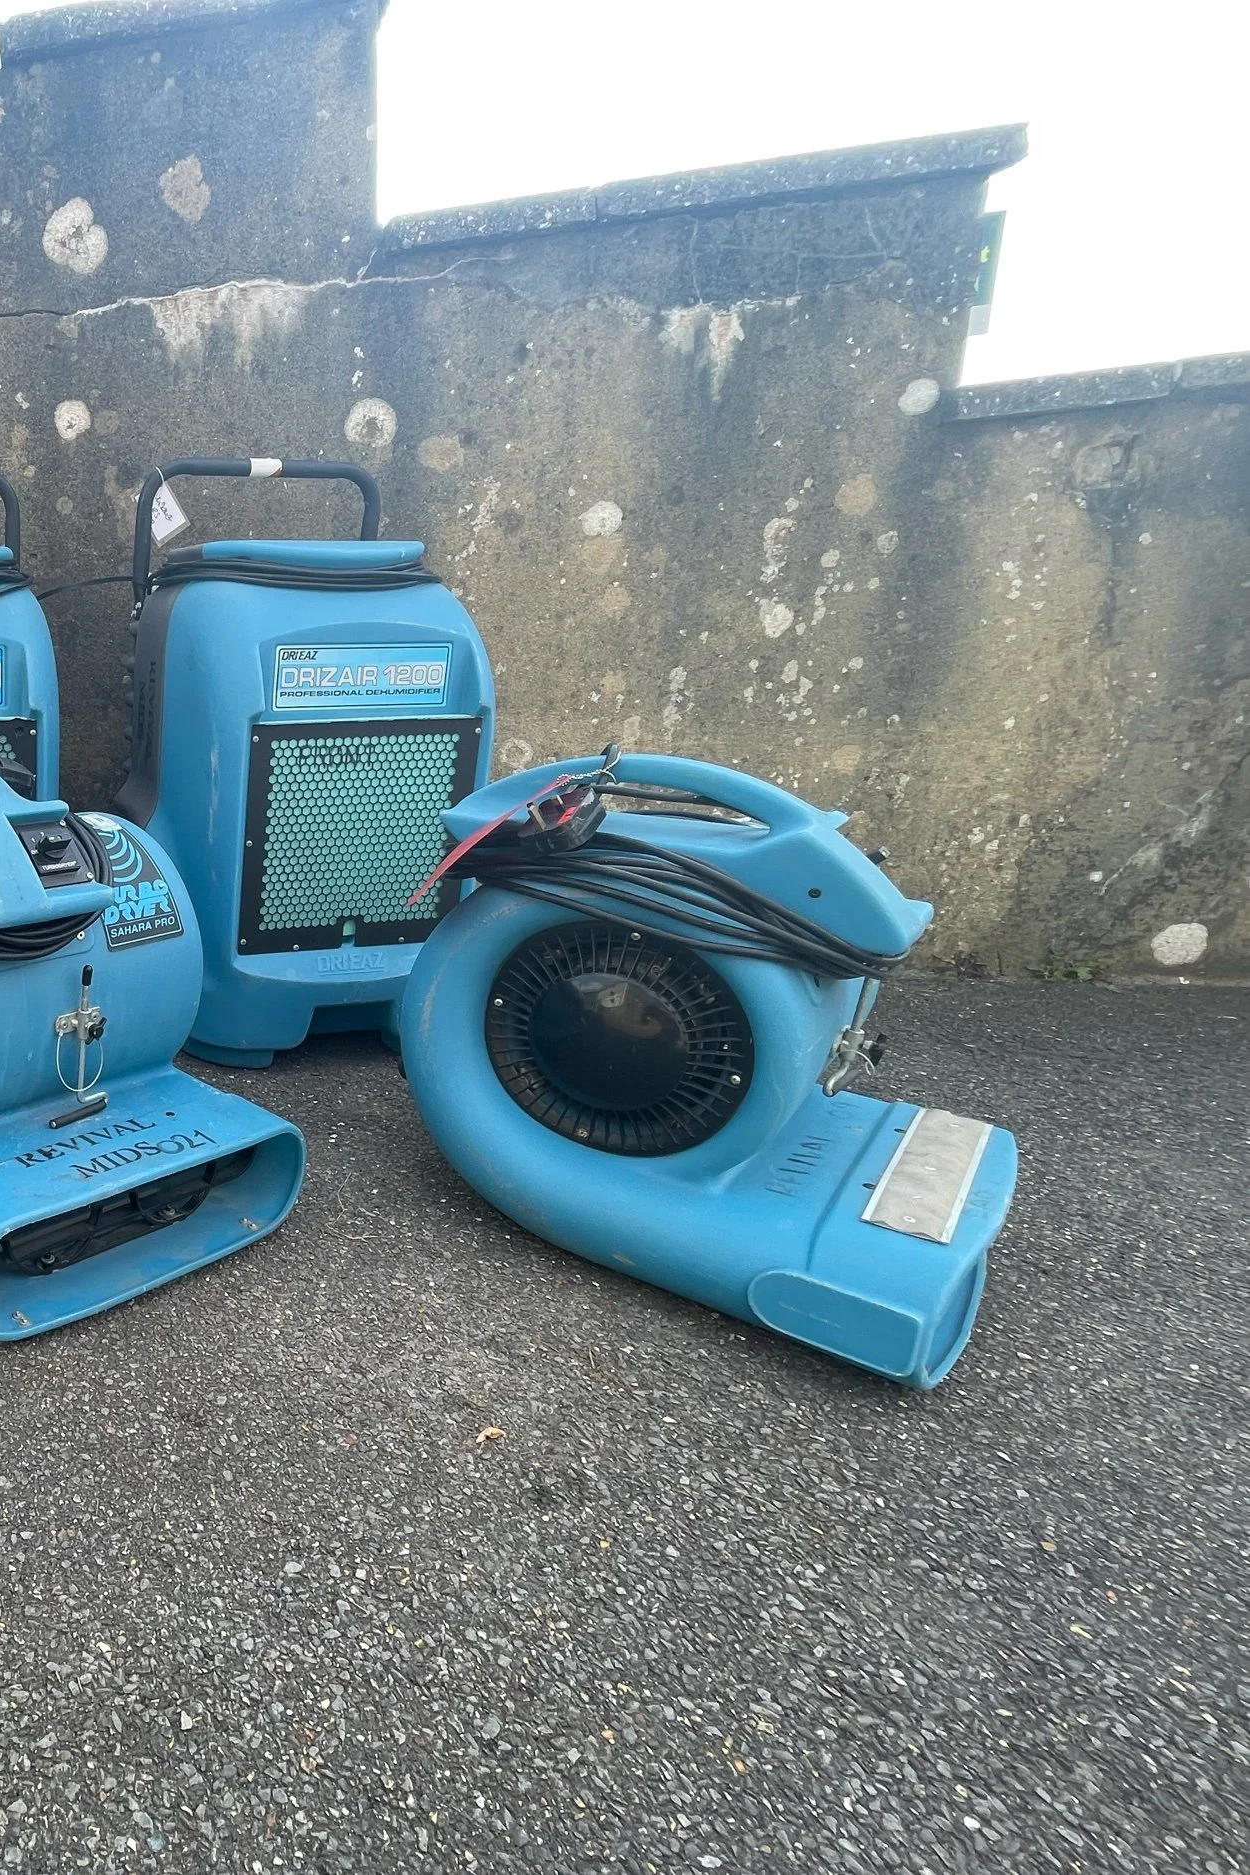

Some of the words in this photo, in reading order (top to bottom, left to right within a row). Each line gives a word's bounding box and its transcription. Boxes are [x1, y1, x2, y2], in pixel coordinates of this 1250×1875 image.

[281, 666, 378, 688] DRIZAIR
[383, 664, 443, 686] 1200
[366, 688, 441, 696] DEHUMIDIFIER
[113, 879, 169, 904] URBO
[104, 895, 172, 925] DRYER
[111, 921, 152, 938] SAHARA
[155, 916, 175, 928] PRO
[14, 1118, 157, 1168] REVIVAL
